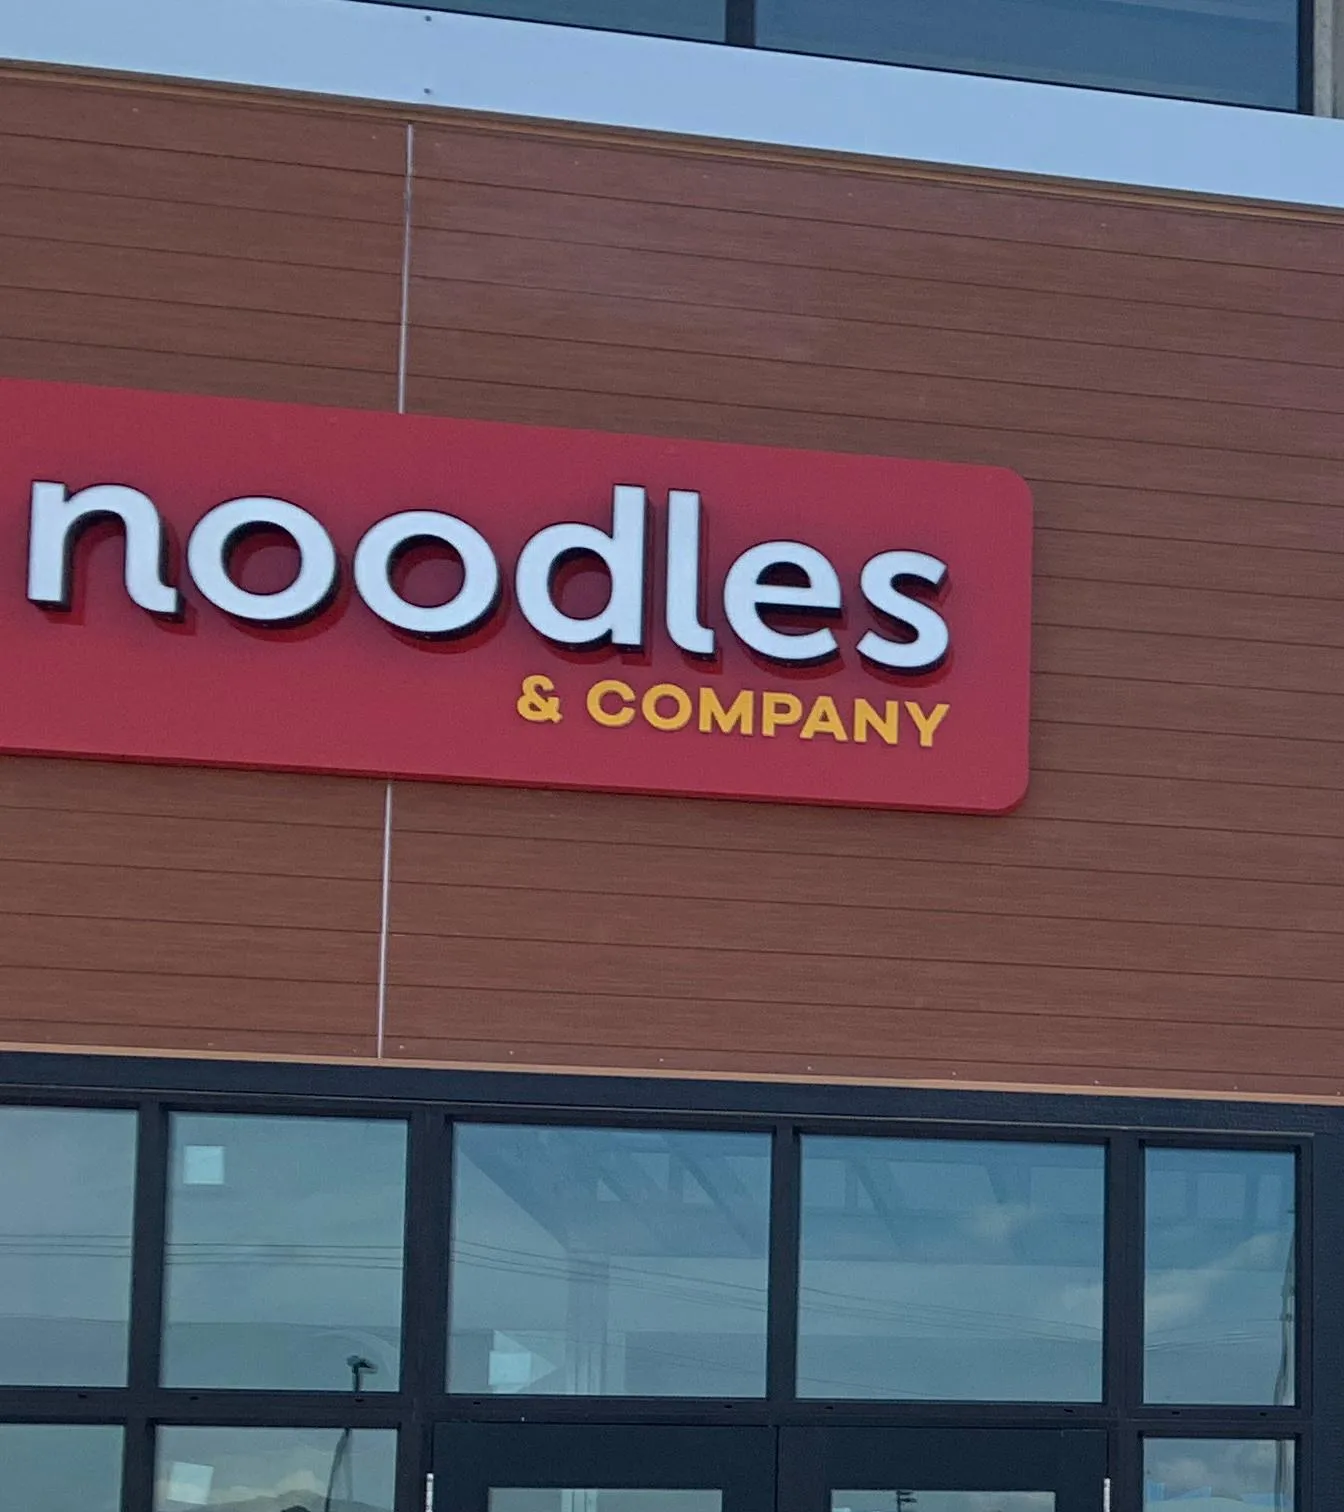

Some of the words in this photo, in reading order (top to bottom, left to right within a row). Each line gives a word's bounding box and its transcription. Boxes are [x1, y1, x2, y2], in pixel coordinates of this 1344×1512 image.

[26, 480, 950, 672] noodles
[516, 675, 562, 723] &
[586, 680, 950, 748] COMPANY
